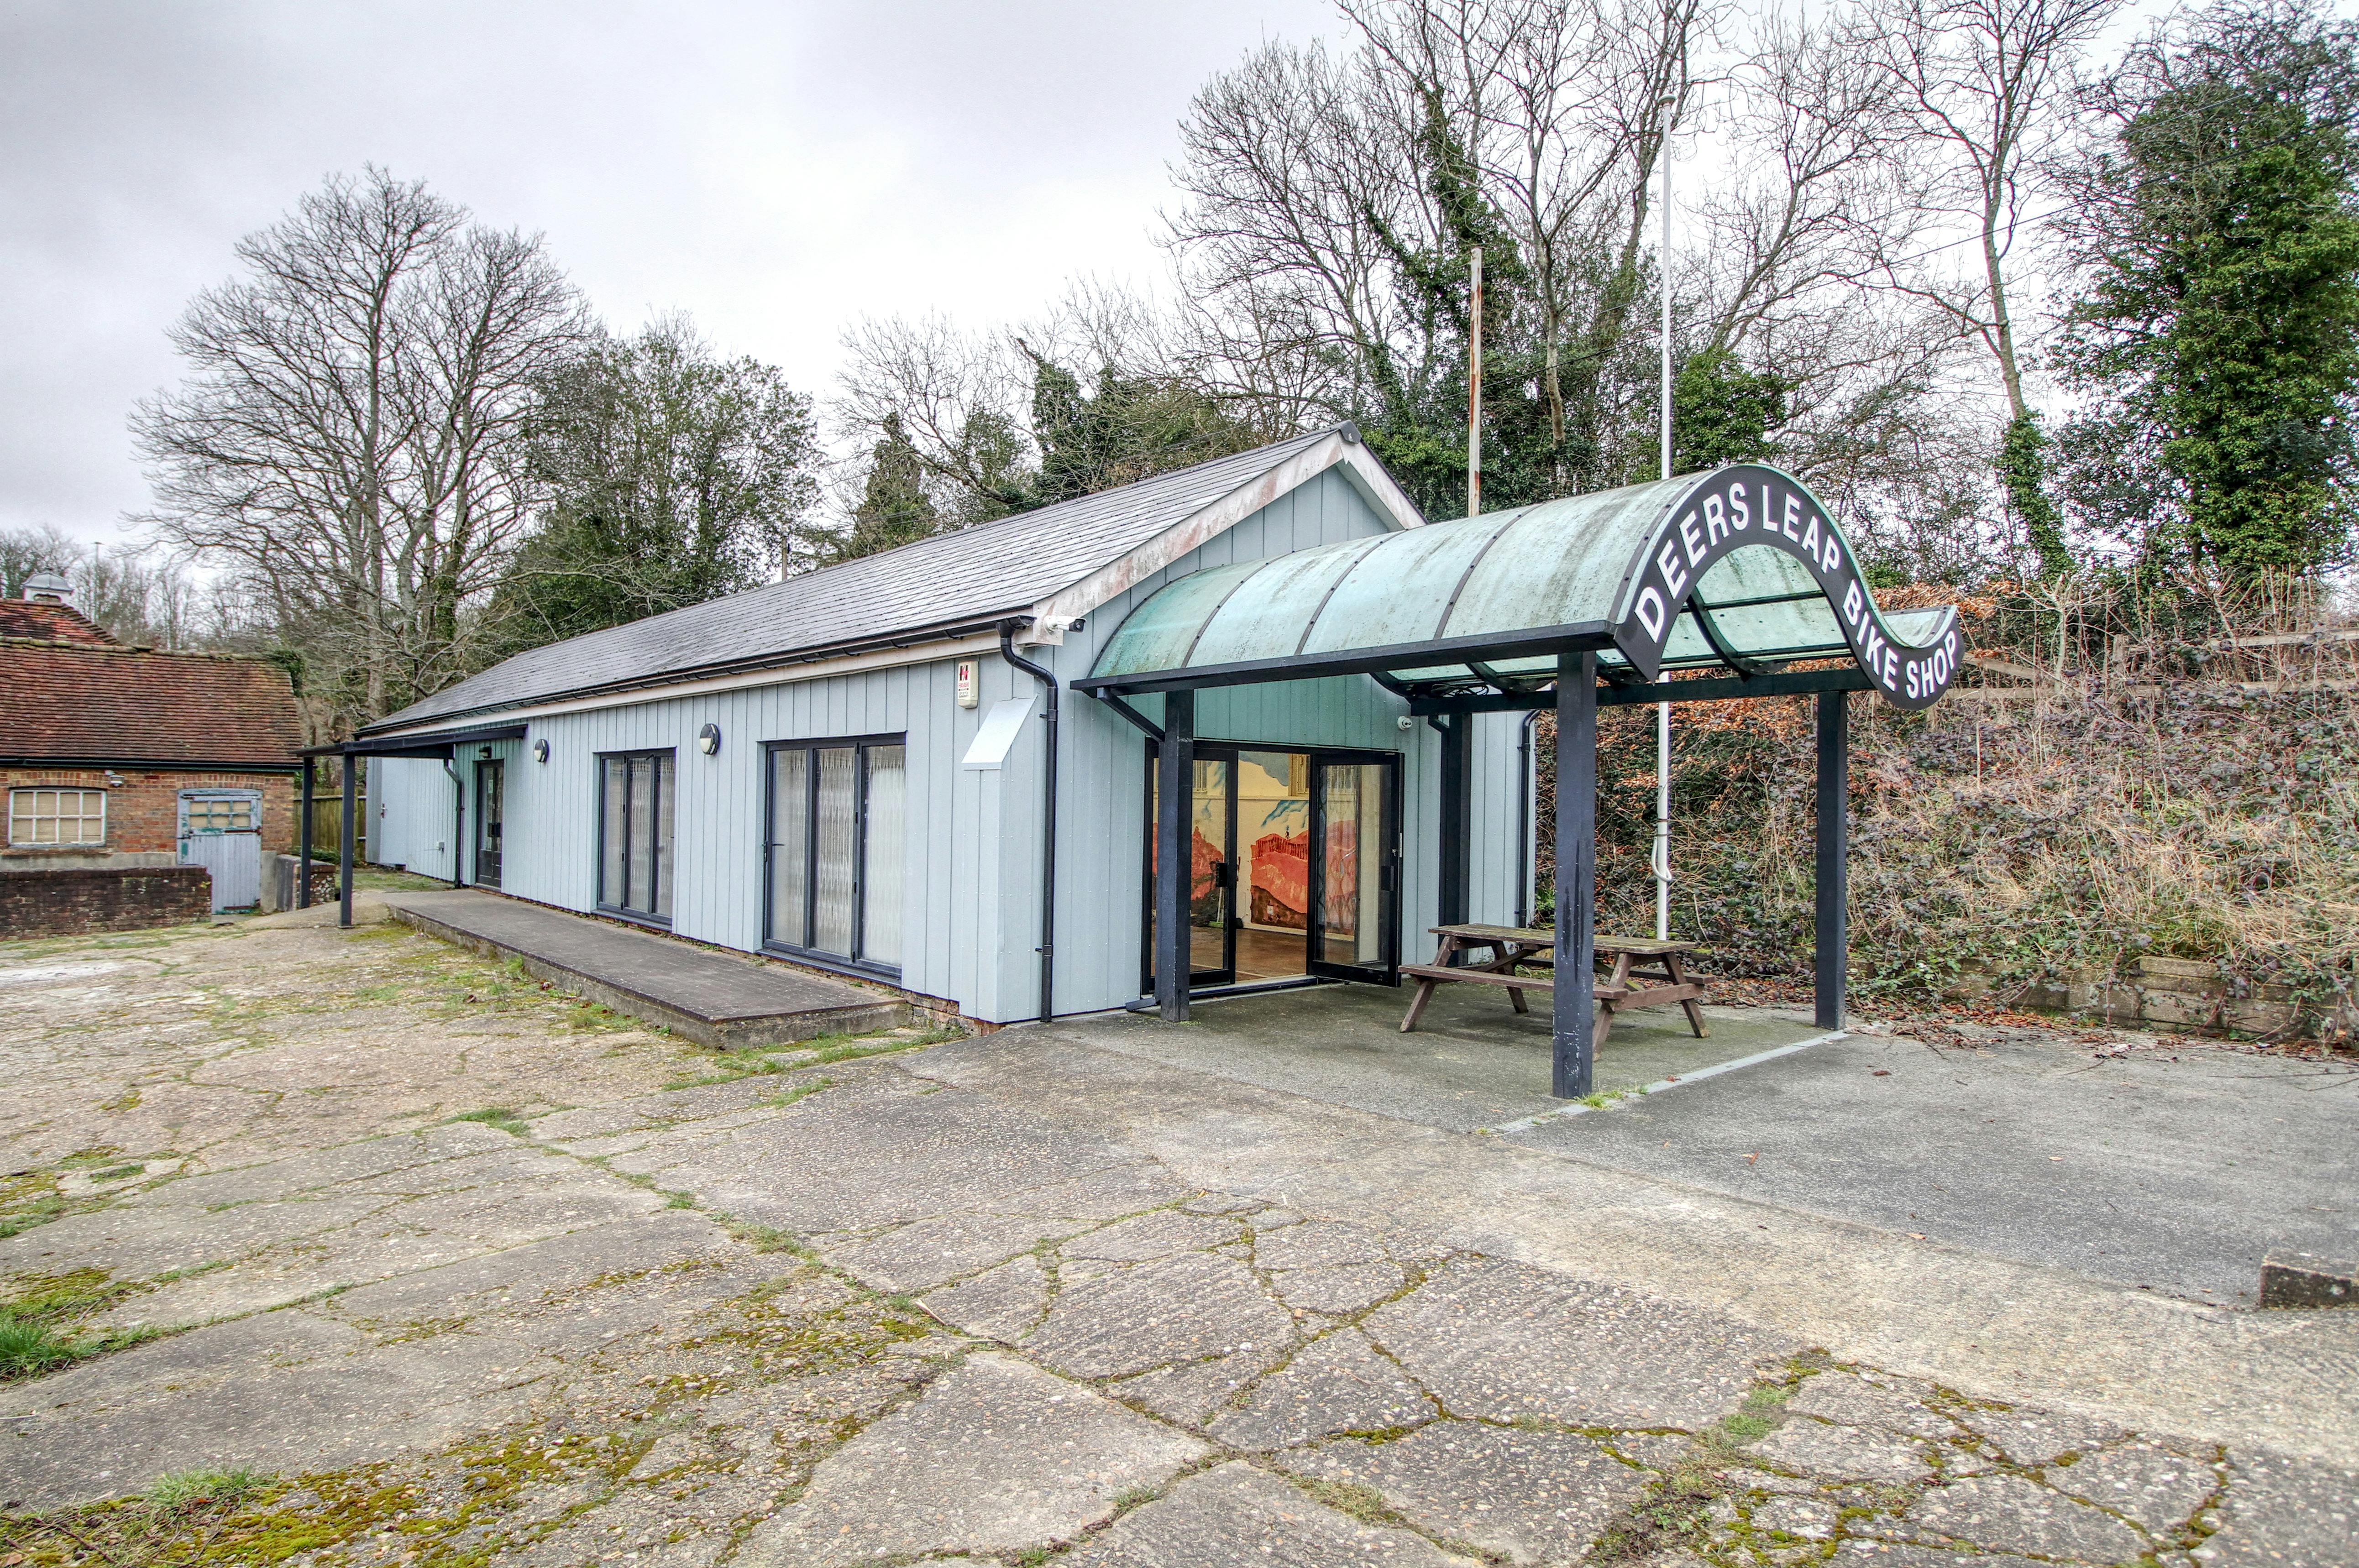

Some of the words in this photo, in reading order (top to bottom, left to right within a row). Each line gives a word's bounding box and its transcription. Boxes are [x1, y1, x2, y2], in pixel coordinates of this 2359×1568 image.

[1634, 483, 1749, 643] DEERS
[1762, 485, 1840, 574] LEAP
[1842, 579, 1898, 691] BIKE
[1906, 631, 1956, 699] SHOP
